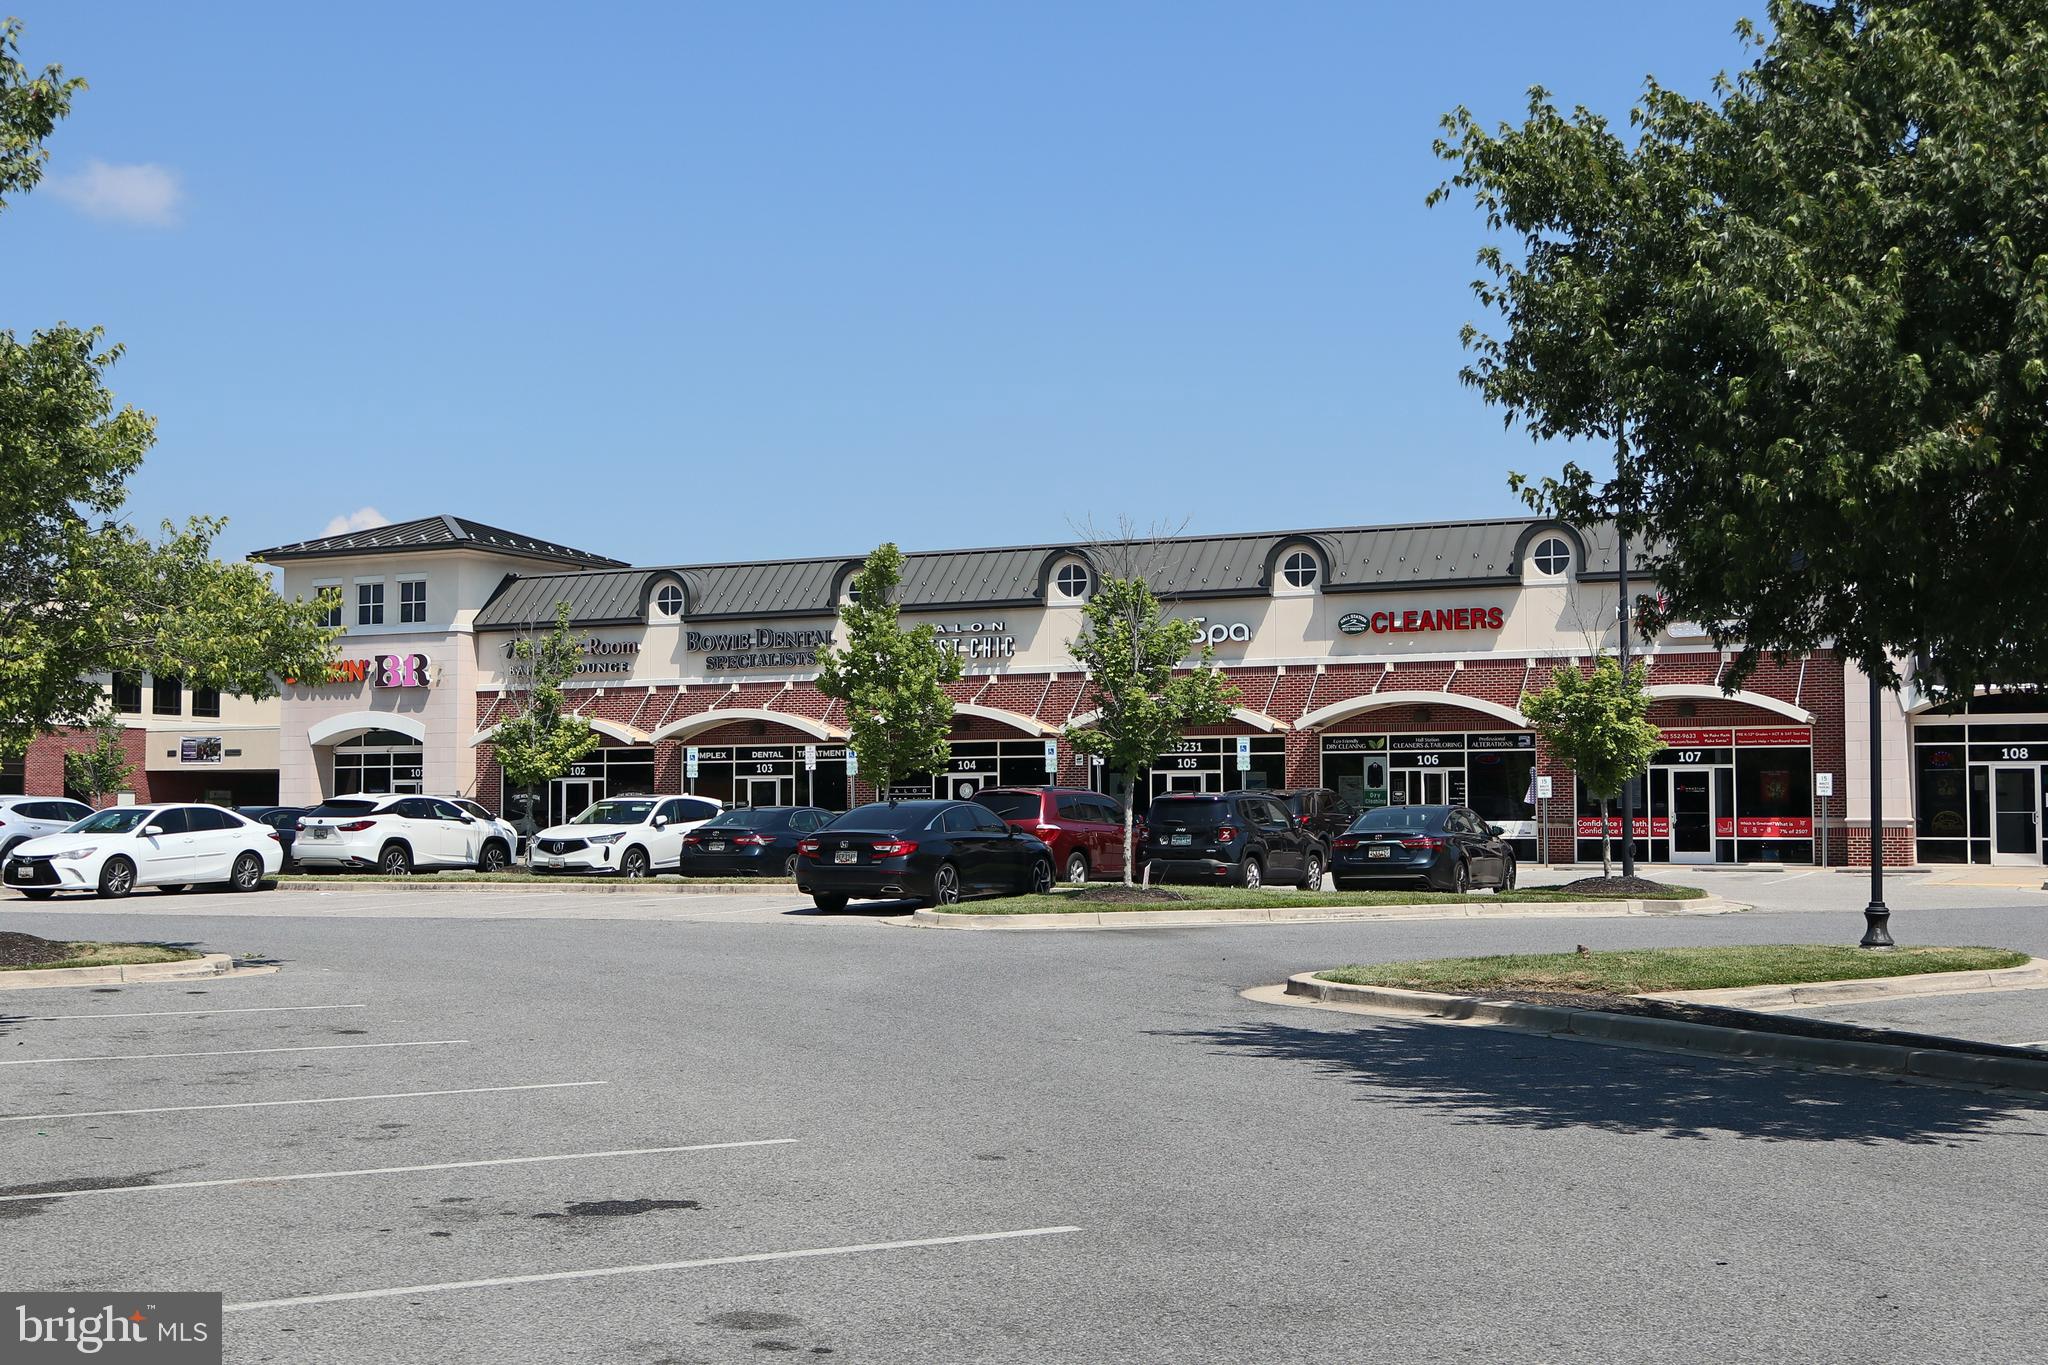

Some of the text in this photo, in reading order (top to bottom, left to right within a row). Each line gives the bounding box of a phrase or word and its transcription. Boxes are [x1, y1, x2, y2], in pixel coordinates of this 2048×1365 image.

[1370, 606, 1505, 634] CLEANERS
[936, 622, 1005, 634] ALON
[1189, 616, 1251, 647] Spa
[588, 637, 641, 655] Room
[686, 628, 837, 652] BOWIE DENTAL
[970, 636, 1014, 659] CHIC
[705, 651, 817, 671] SPECIALISTS
[576, 662, 630, 674] OUNGE
[751, 751, 784, 759] DENTAL
[1678, 751, 1702, 762] 107
[2001, 747, 2029, 759] 108
[957, 760, 977, 770] 104
[1177, 758, 1197, 769] 105
[1417, 754, 1439, 766] 106
[570, 766, 586, 776] 102
[756, 764, 773, 773] 103
